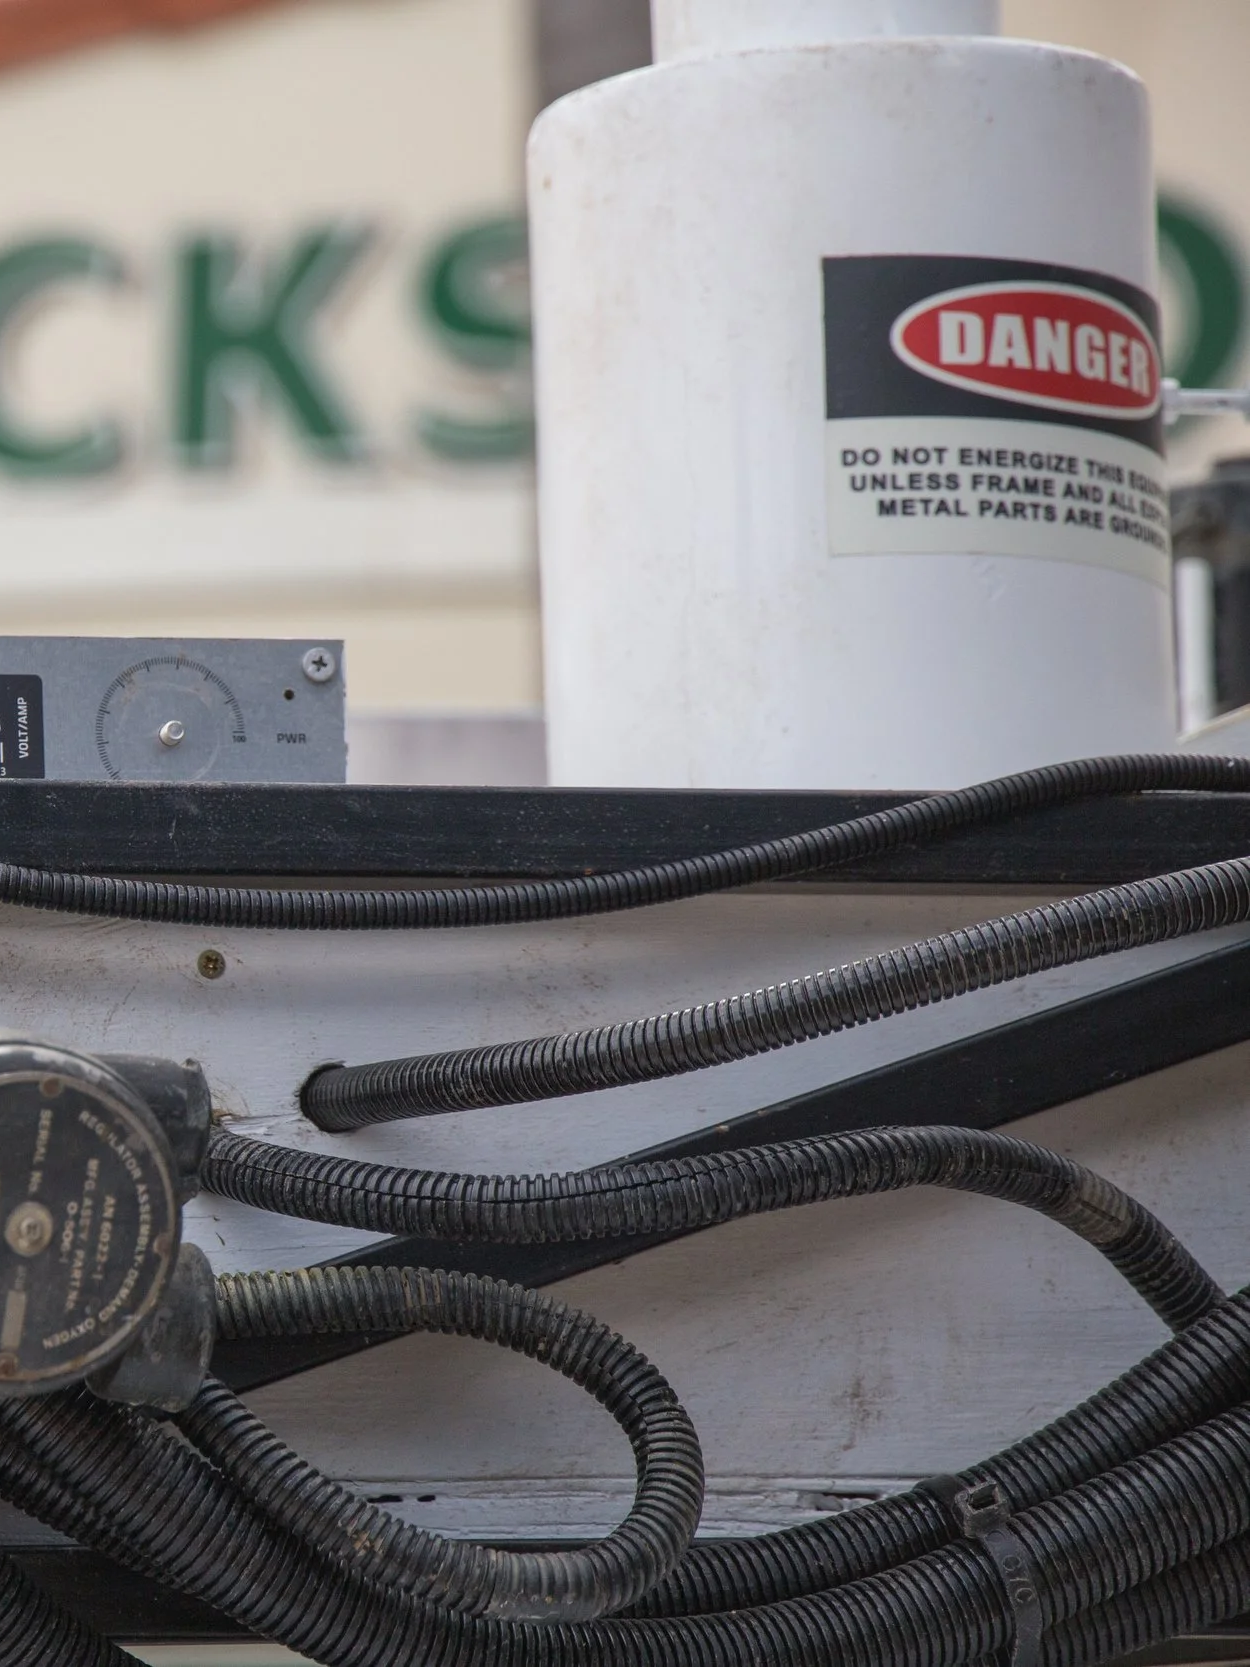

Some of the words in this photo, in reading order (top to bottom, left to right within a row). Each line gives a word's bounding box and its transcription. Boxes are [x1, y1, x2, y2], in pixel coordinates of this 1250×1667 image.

[938, 310, 1151, 398] DANGER
[842, 448, 881, 467] DO
[892, 447, 948, 466] NOT
[958, 448, 1079, 475] ENERGIZE
[1085, 458, 1125, 485] THIS
[851, 473, 960, 492] UNLESS
[972, 473, 1055, 497] FRAME
[1062, 482, 1103, 505] AND
[1108, 489, 1139, 515] ALL
[877, 498, 968, 517] METAL
[979, 500, 1057, 523] PARTS
[1064, 507, 1104, 530] ARE
[17, 696, 29, 759] VOLT/AMP
[276, 733, 307, 744] PWR
[0, 766, 7, 776] 3
[33, 1108, 53, 1164] SERIAL
[43, 1316, 96, 1350] OXYGEN
